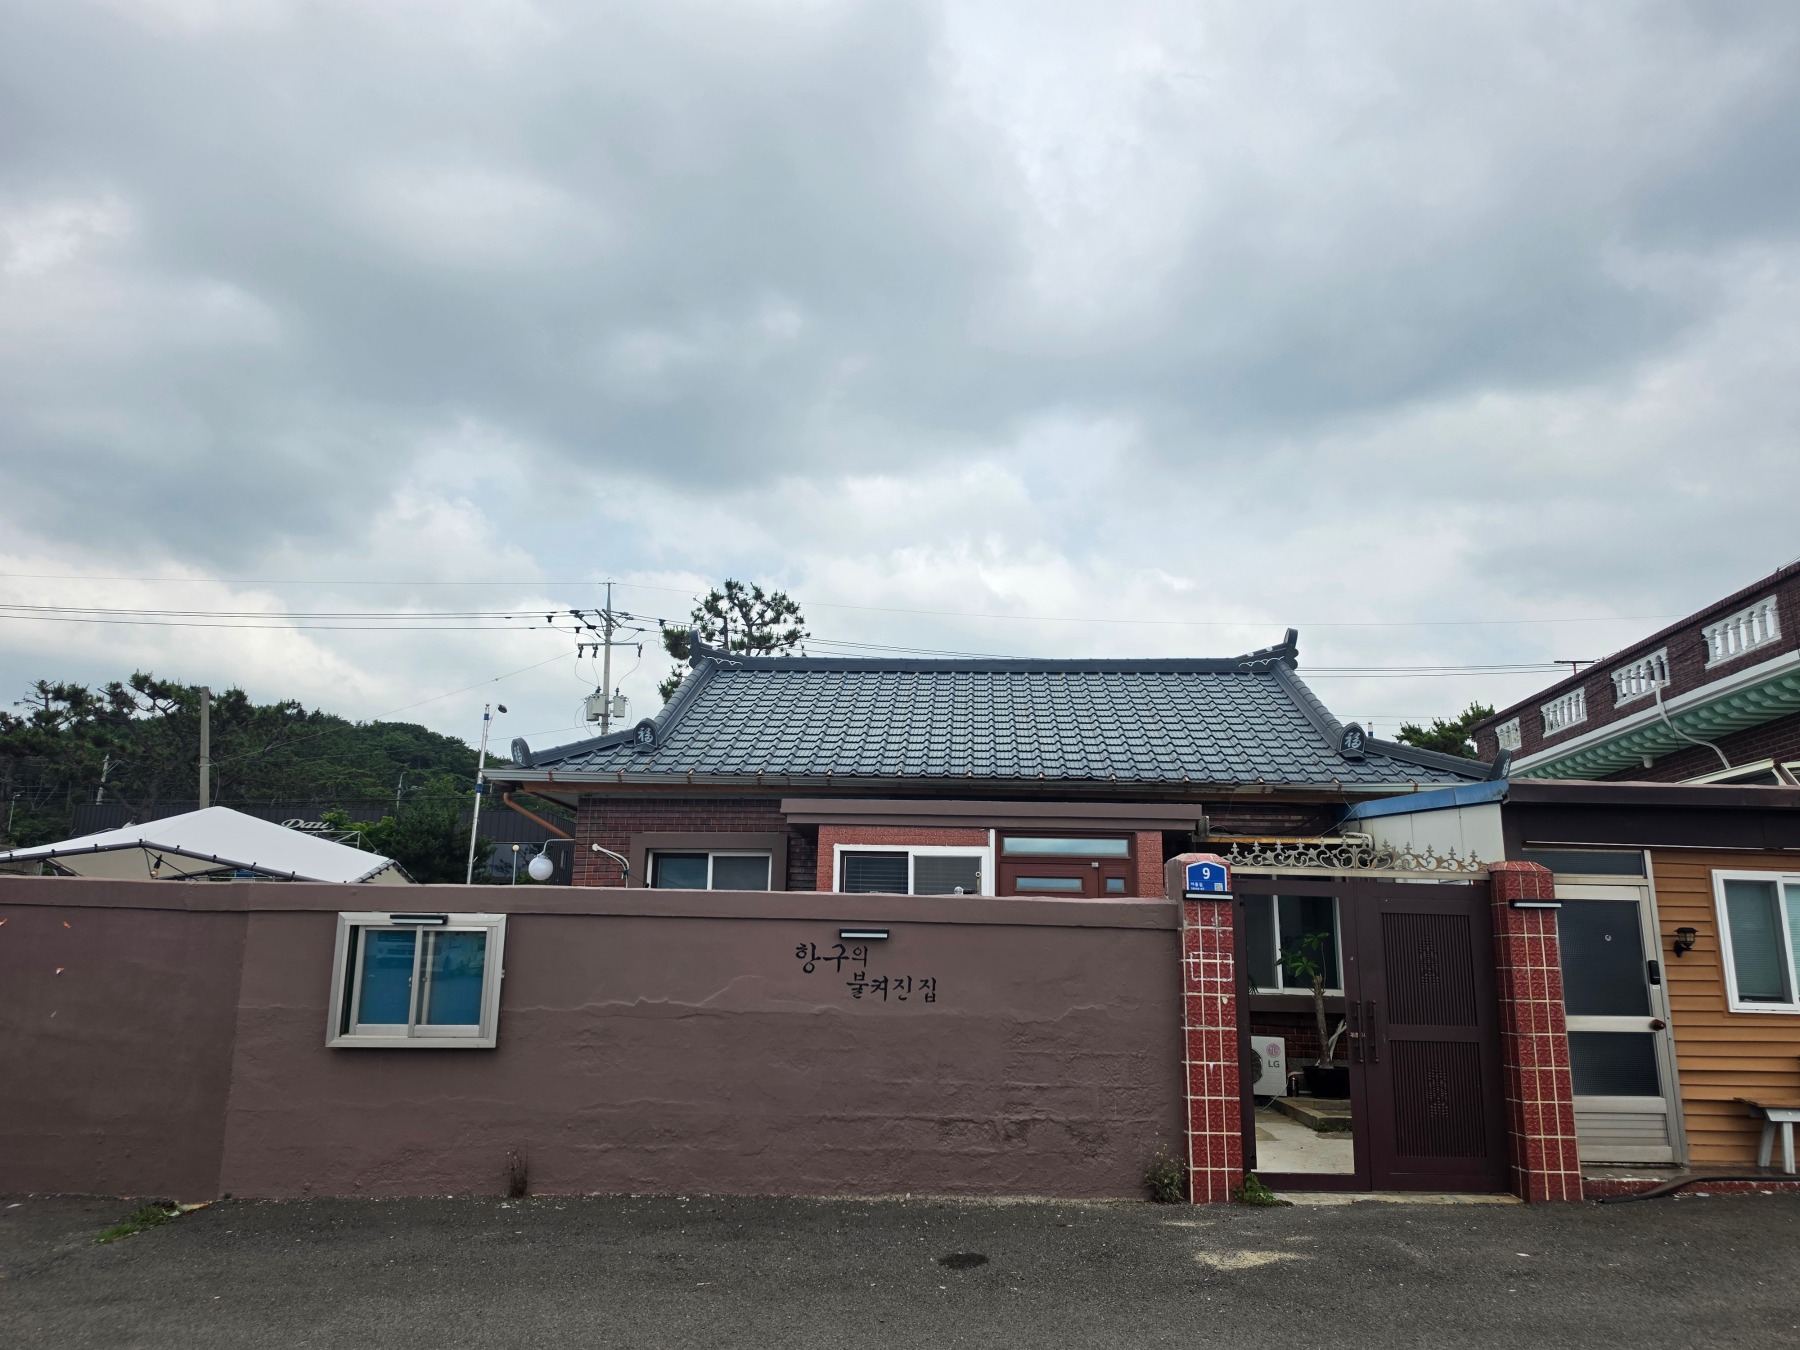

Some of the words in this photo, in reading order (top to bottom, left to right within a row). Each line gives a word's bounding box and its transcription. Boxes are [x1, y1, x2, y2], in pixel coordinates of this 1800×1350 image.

[1344, 732, 1362, 749] 福
[1202, 867, 1211, 880] 9
[795, 942, 869, 974] 항구의
[1268, 1060, 1280, 1068] LG
